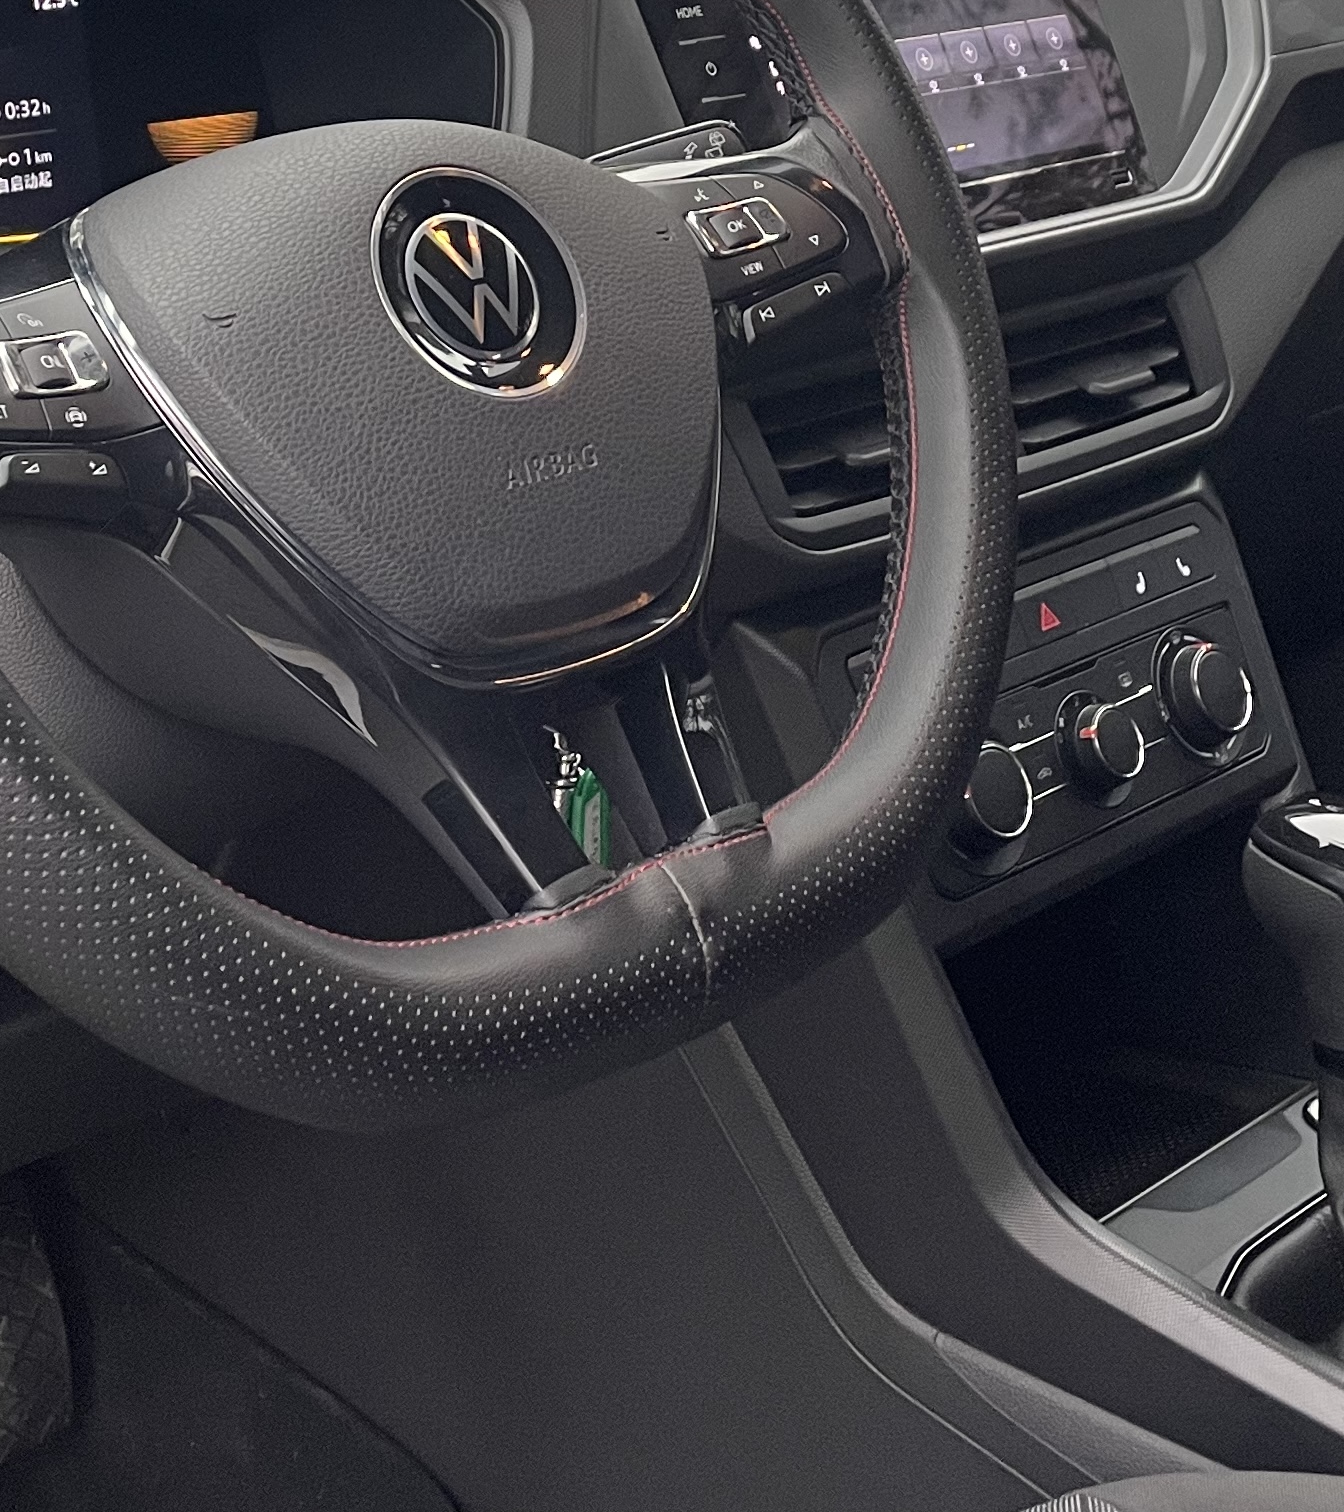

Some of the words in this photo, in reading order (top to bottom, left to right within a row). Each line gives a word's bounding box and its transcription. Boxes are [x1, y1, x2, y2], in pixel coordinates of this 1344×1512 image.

[675, 5, 704, 19] HOME
[5, 99, 41, 120] 0:32
[23, 147, 33, 166] 1
[34, 150, 54, 164] km
[727, 219, 747, 233] OK
[740, 260, 764, 276] VIEW
[507, 443, 599, 490] AIRBAG
